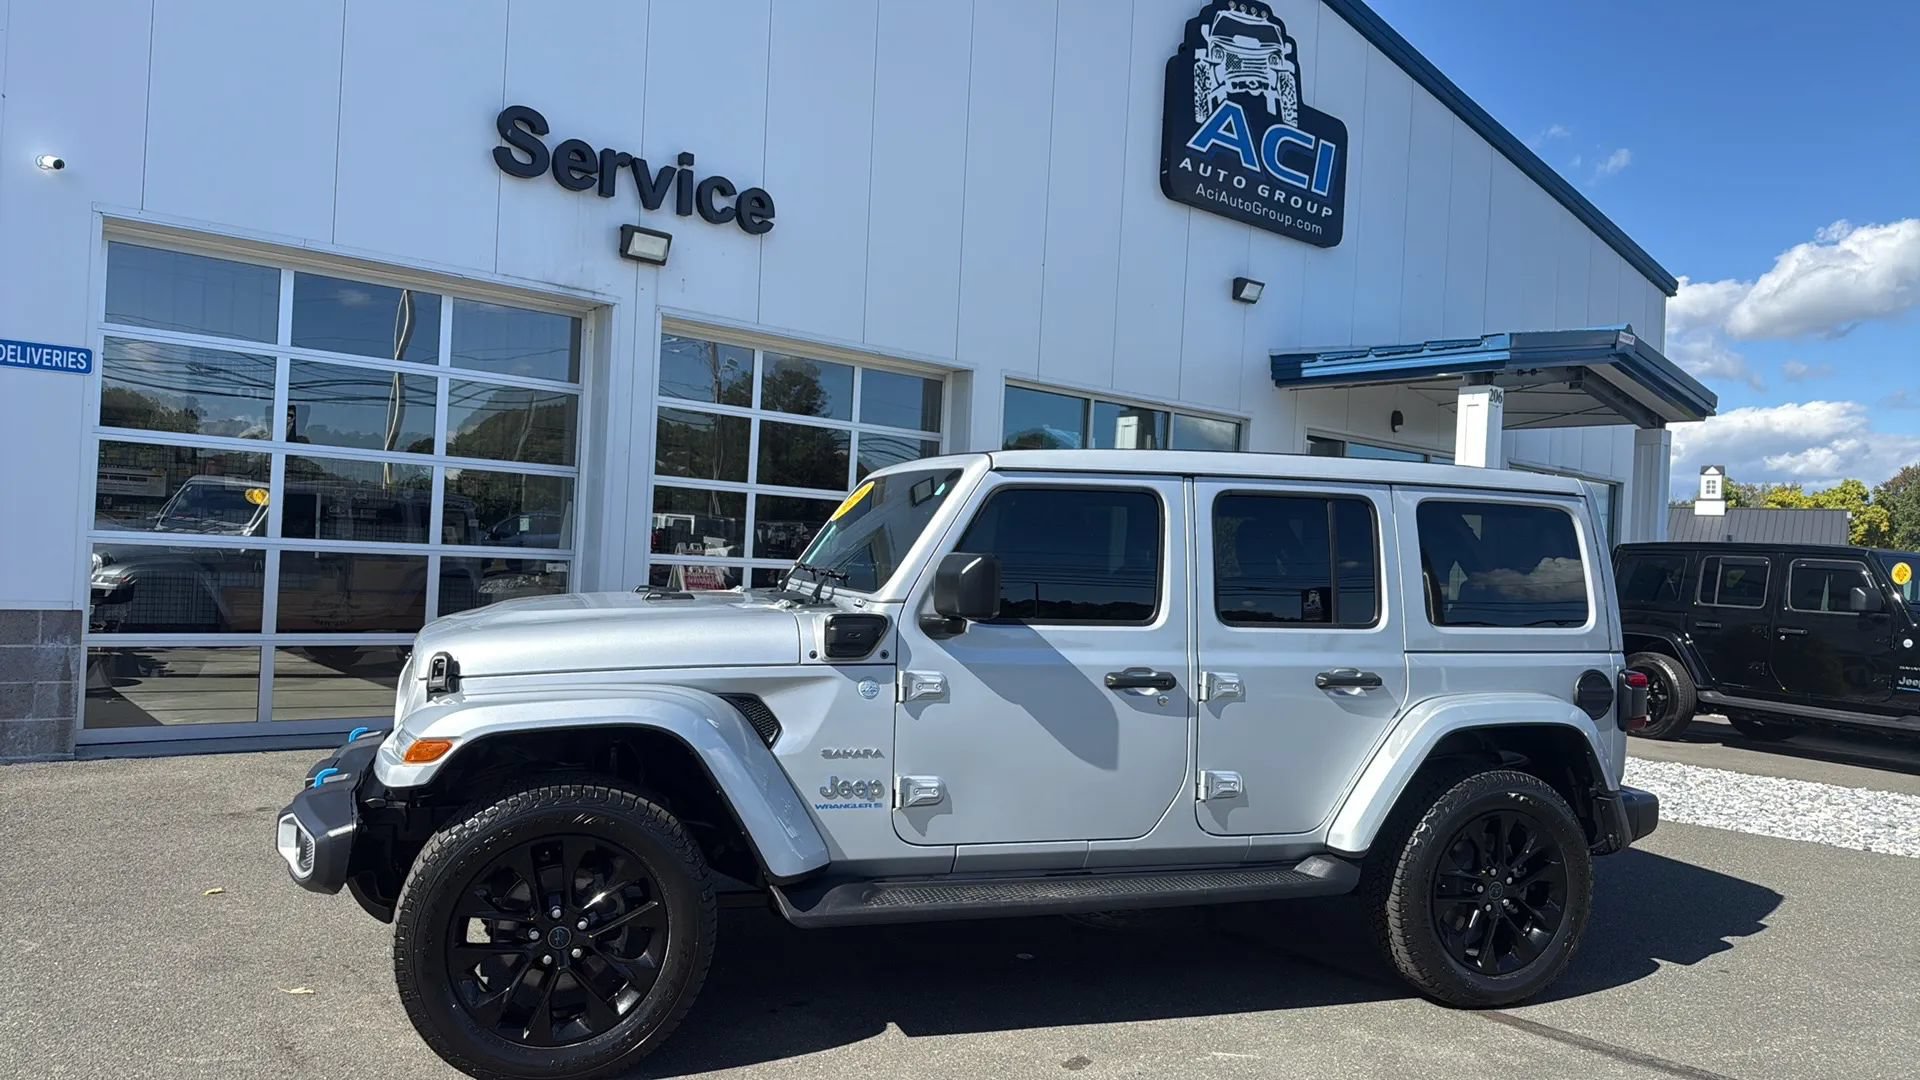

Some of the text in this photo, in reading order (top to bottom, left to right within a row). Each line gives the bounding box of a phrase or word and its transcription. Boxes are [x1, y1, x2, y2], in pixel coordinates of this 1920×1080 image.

[1186, 99, 1336, 197] ACI
[492, 105, 775, 235] Service
[1179, 157, 1333, 218] AUTO GROUP
[1195, 183, 1323, 236] AciAutoGroup.com
[0, 343, 87, 370] DELIVERIES
[1489, 388, 1503, 404] 206
[821, 748, 885, 759] SAHARA
[819, 775, 886, 802] Jeep
